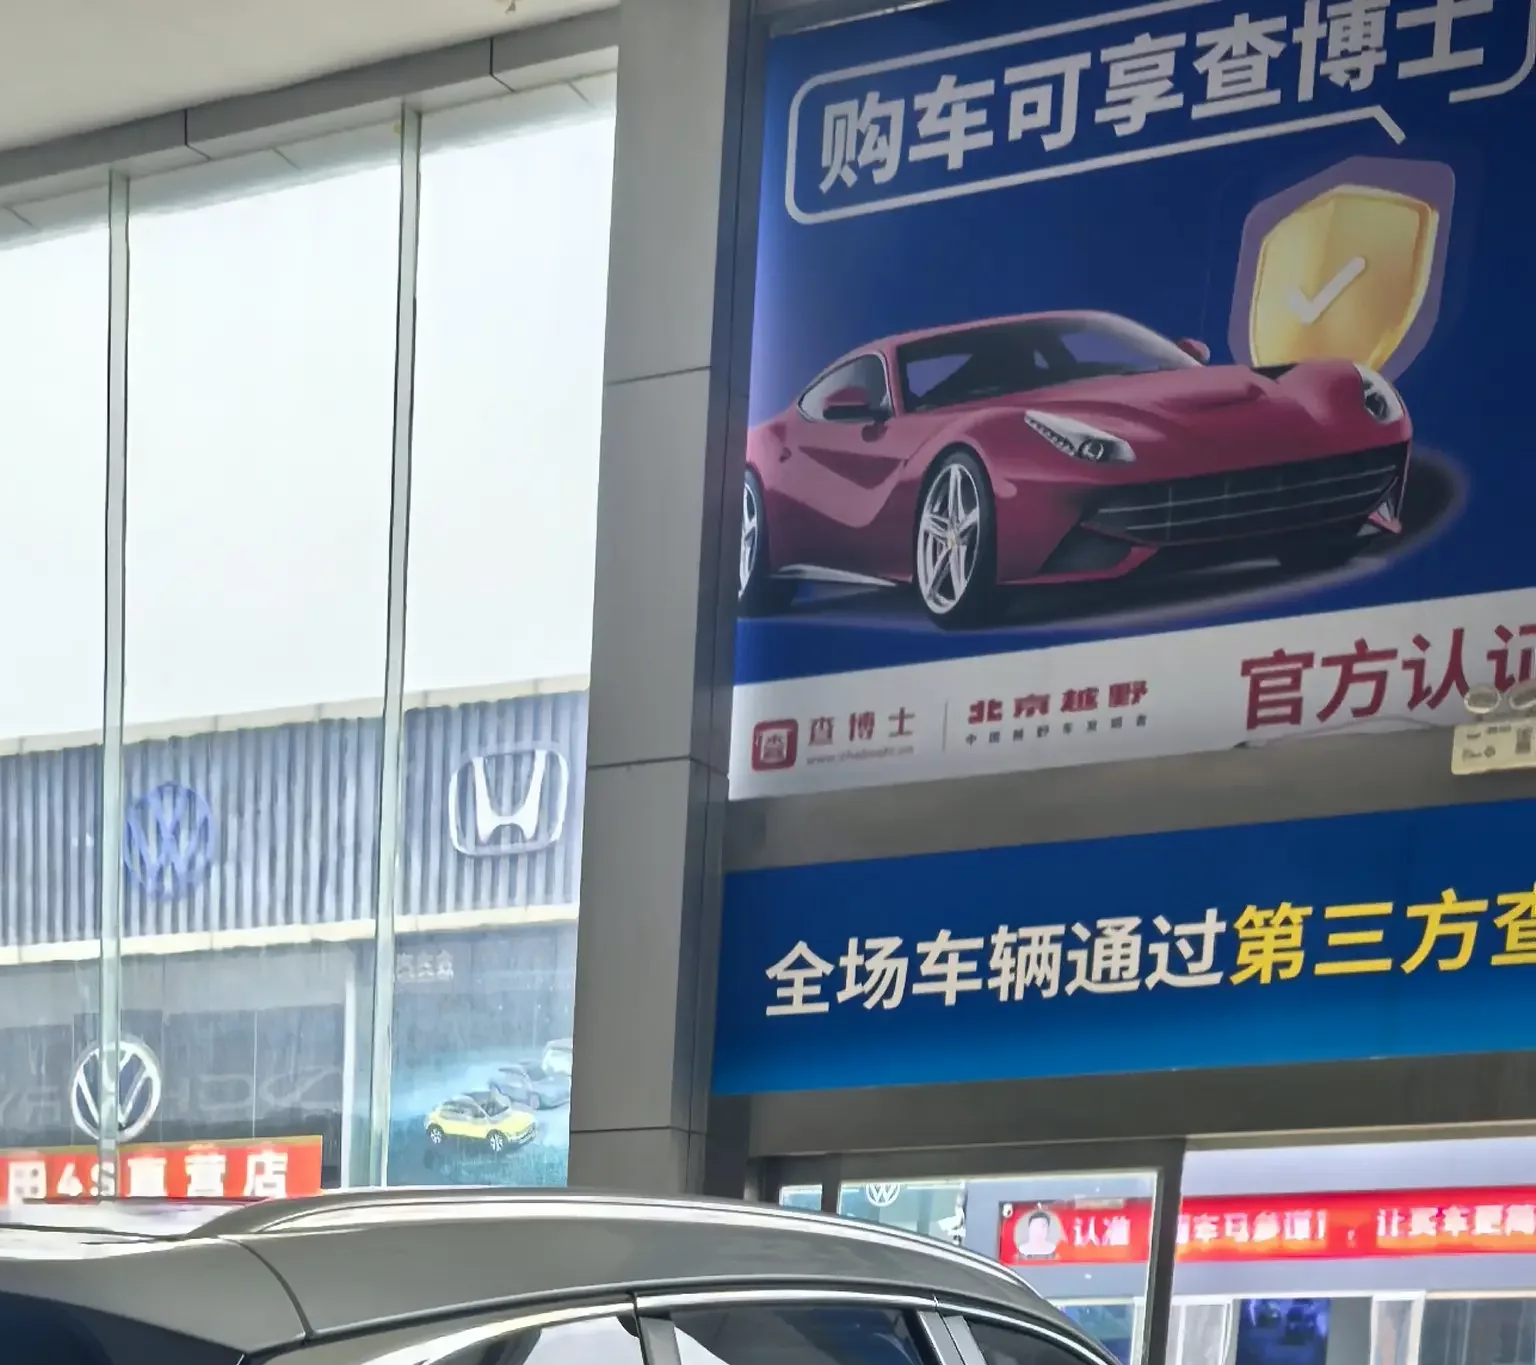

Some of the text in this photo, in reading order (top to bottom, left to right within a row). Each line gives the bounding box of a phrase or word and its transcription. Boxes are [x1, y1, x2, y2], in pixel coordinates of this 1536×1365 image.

[819, 0, 1493, 193] 购车可享查博士
[808, 706, 915, 747] 查博士
